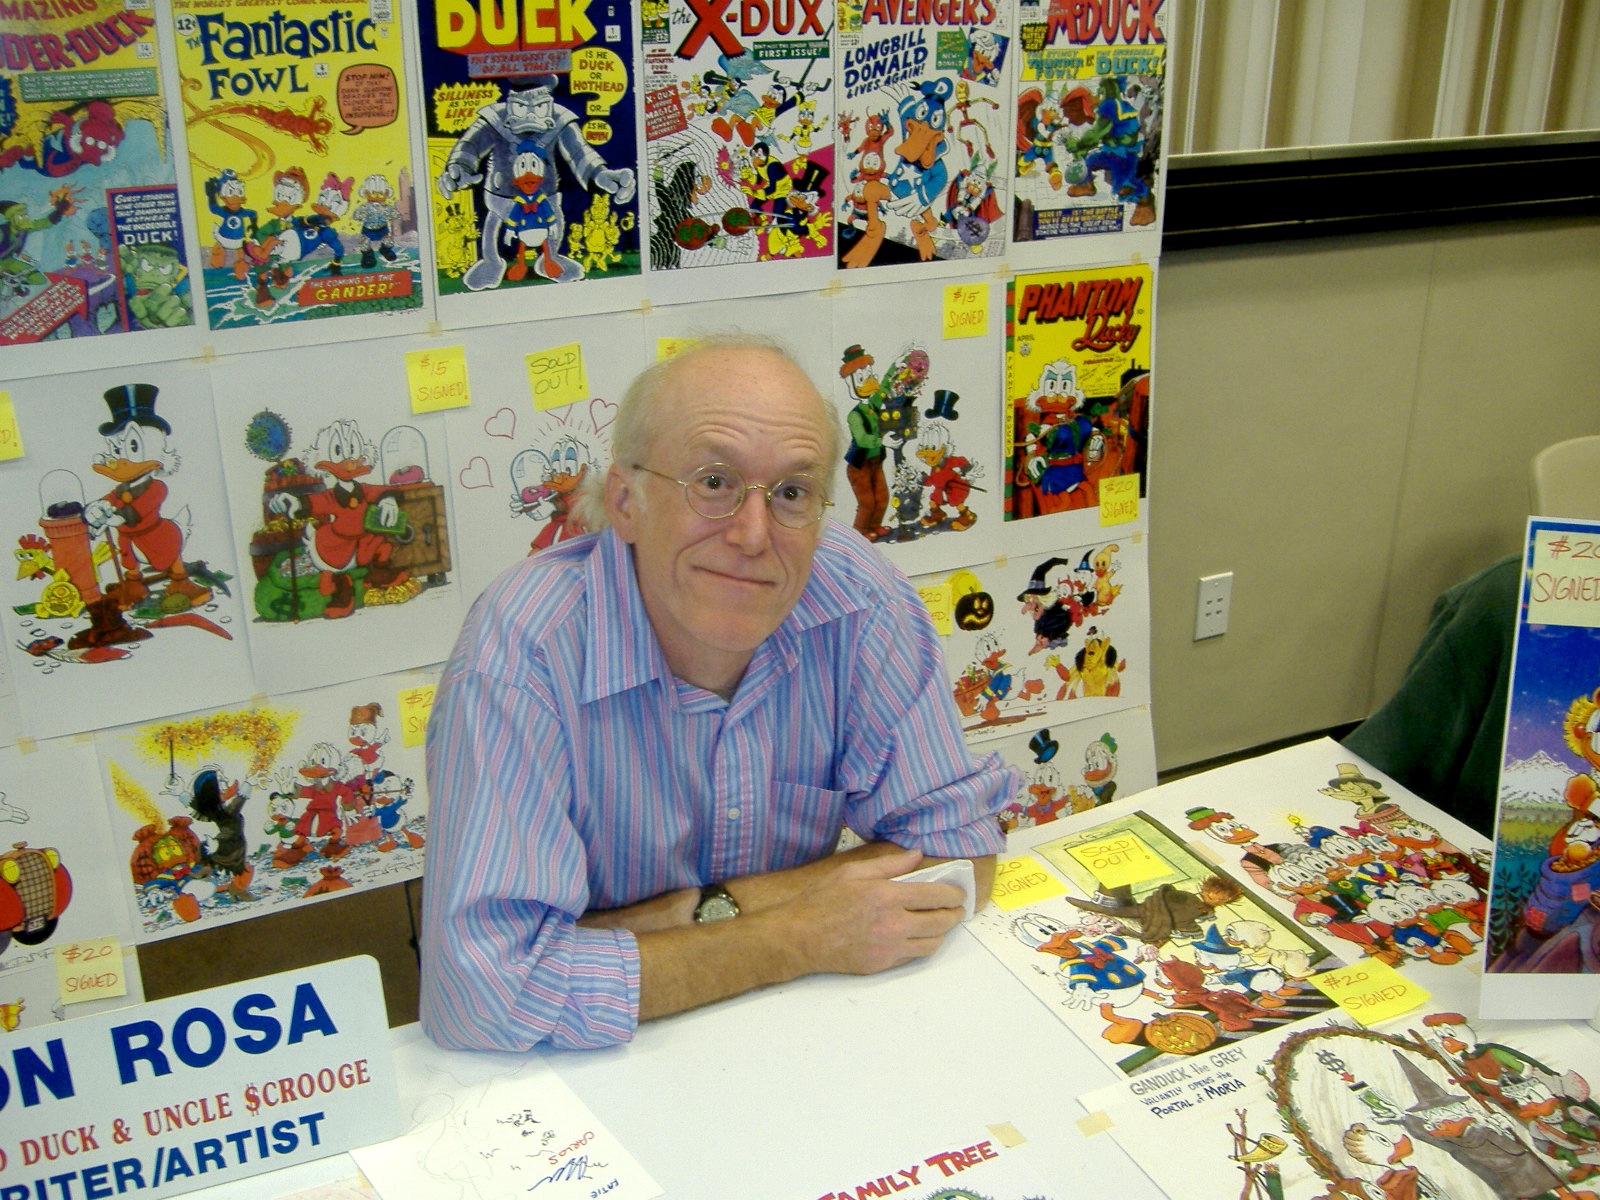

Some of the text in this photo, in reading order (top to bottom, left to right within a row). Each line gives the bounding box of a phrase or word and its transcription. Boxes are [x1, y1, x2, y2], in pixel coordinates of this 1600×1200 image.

[861, 0, 997, 26] AVENGERS
[0, 10, 155, 71] DER-DUCK
[195, 10, 378, 66] Fantastic
[672, 0, 825, 61] the X-DUX
[597, 51, 608, 59] HE
[759, 48, 823, 58] FIRST ISSUE!
[843, 28, 927, 70] LONGBILL
[471, 56, 487, 64] THE
[482, 65, 495, 73] OF
[497, 63, 518, 72] ALL
[579, 59, 614, 71] DUCK
[844, 46, 929, 88] DONALD
[1096, 56, 1159, 76] DUCK!
[207, 64, 309, 100] FOWL
[573, 80, 625, 92] HOTHEAD
[590, 72, 602, 80] OR
[846, 63, 926, 99] LIVES AGAIN!
[438, 90, 493, 102] SILLINESS
[445, 108, 475, 118] LIKE
[453, 117, 467, 126] IT!
[645, 104, 679, 119] MAGICA
[123, 230, 179, 245] DUCK!
[315, 282, 395, 301] GANDER!
[326, 277, 360, 287] COMING
[363, 275, 375, 283] OF
[953, 287, 980, 304] $15
[1018, 276, 1144, 325] PHANTOM
[948, 309, 985, 328] SIGNED
[419, 357, 448, 376] $15
[530, 352, 577, 374] SOLD
[1080, 840, 1130, 858] SOLD
[992, 871, 1048, 898] SIGNED
[62, 943, 113, 964] $20
[65, 972, 119, 993] SIGNED
[1323, 971, 1369, 990] $20
[1343, 984, 1408, 1010] SIGNED
[110, 982, 339, 1086] ROSA
[1129, 1046, 1248, 1096] GANDUCK the GREY
[1140, 1070, 1233, 1107] VALIANTLY OPENS the
[1150, 1078, 1247, 1119] PORTAL of MORIA
[19, 1125, 100, 1166] DUCK
[112, 1118, 133, 1145] &
[143, 1092, 233, 1138] UNCLE
[244, 1057, 372, 1117] $CROOGE
[548, 1131, 596, 1165] CARLOS
[924, 1140, 999, 1177] TREE
